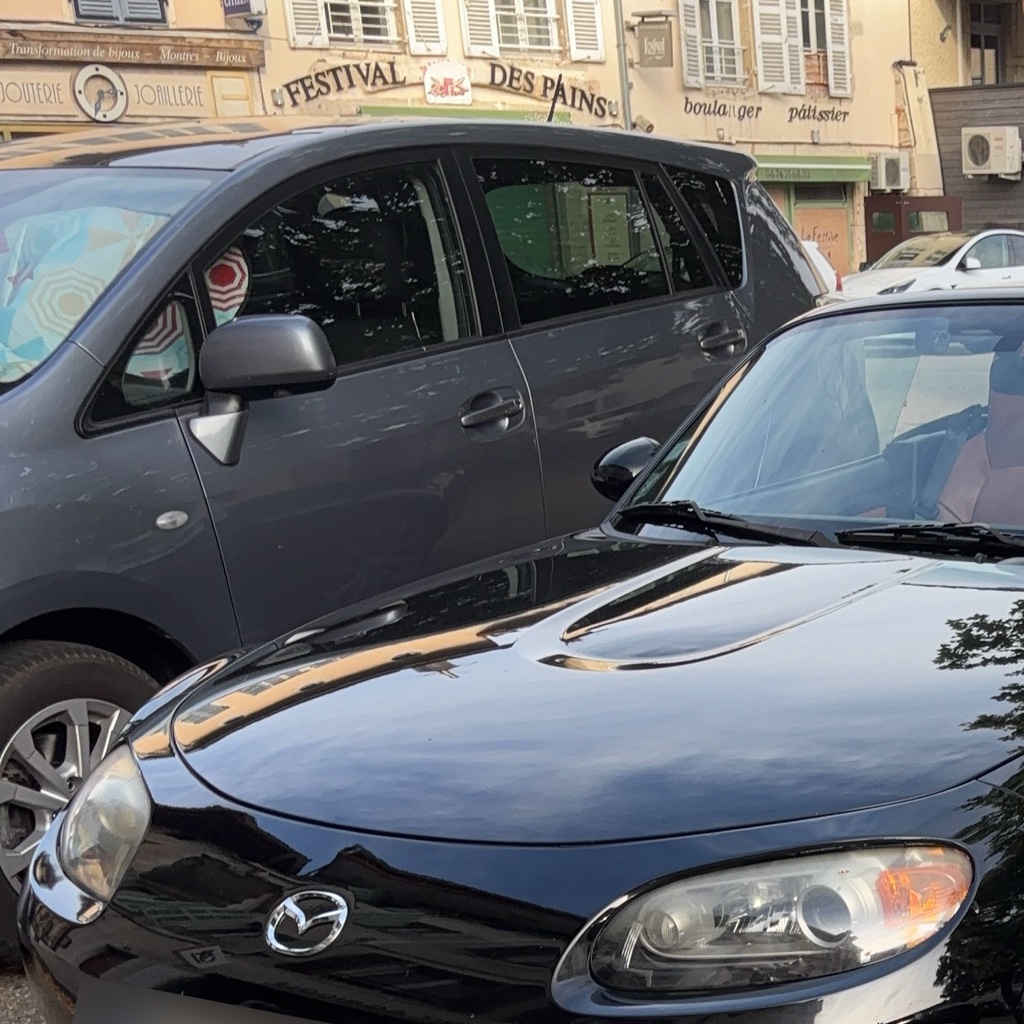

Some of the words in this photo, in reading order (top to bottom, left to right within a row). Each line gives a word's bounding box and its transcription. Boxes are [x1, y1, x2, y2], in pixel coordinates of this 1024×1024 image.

[9, 42, 90, 58] Transformation
[93, 45, 105, 58] de
[108, 46, 140, 60] bijoux
[160, 49, 200, 61] Montres
[216, 50, 246, 64] Bijoux
[134, 84, 204, 106] JOAILLERIE
[283, 61, 406, 107] FESTIVAL
[489, 62, 535, 94] DES
[541, 74, 607, 118] PAINS
